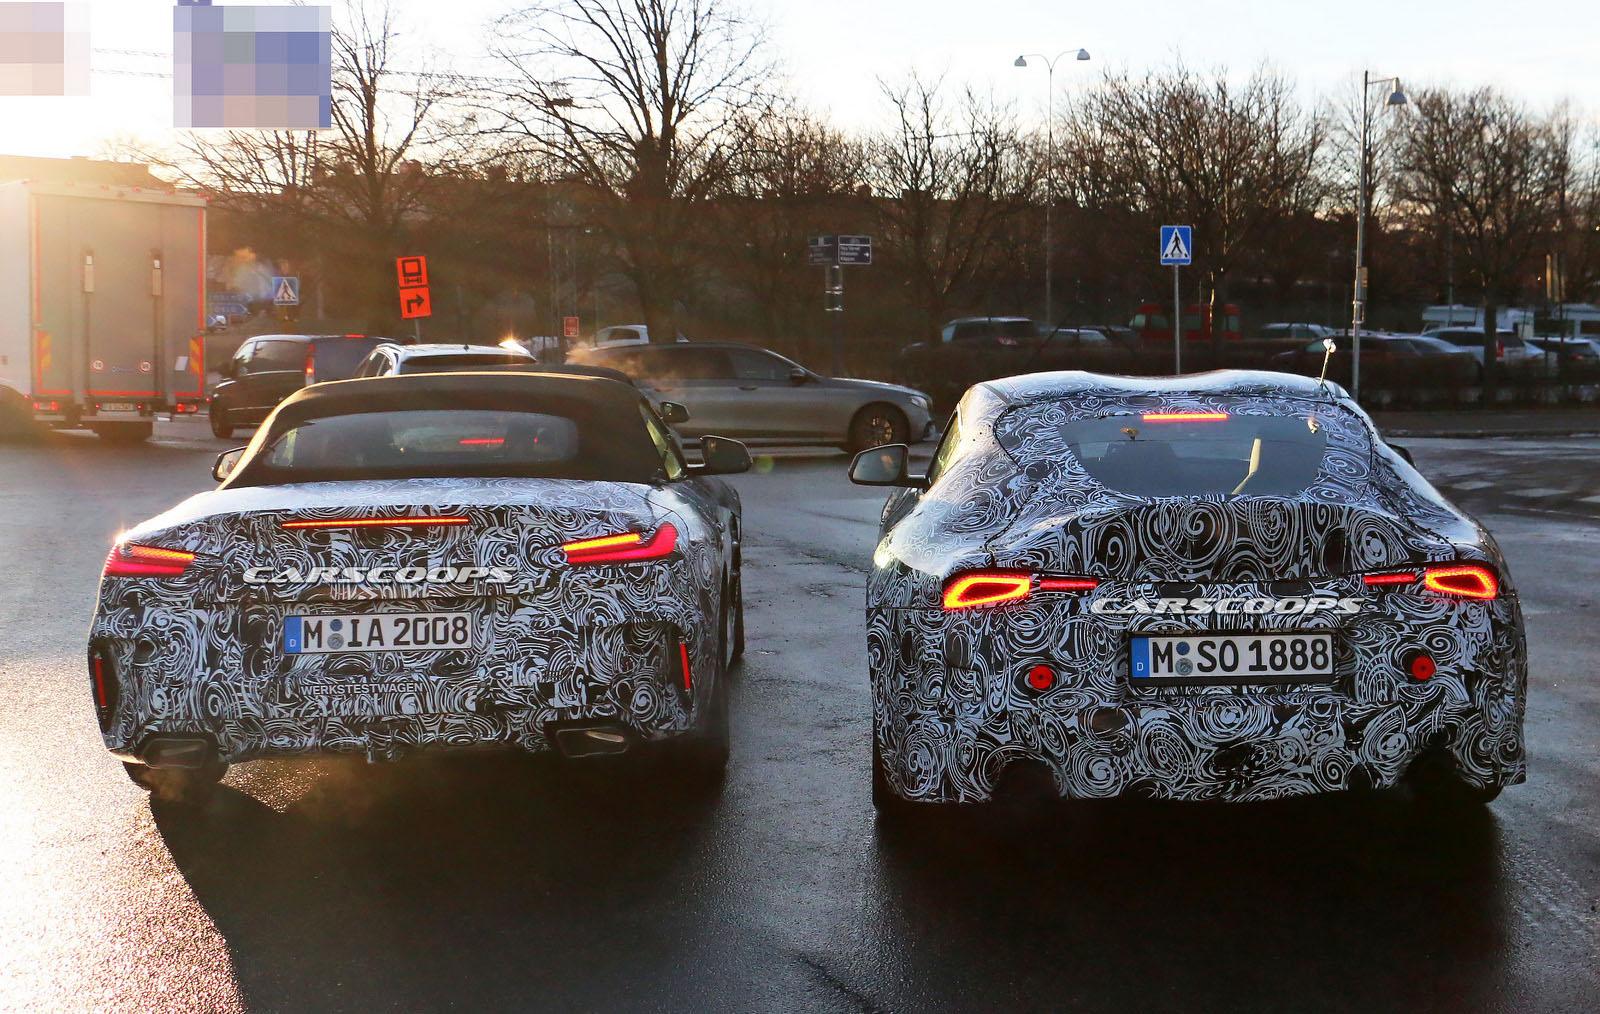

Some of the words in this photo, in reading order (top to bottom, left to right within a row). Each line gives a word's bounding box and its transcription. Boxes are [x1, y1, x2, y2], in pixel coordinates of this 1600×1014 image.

[303, 619, 323, 649] M
[347, 618, 385, 648] IA
[393, 616, 469, 646] 2008
[289, 638, 297, 648] D
[1152, 641, 1174, 674] M
[1197, 639, 1240, 673] SO
[1248, 638, 1330, 672] 1888
[1136, 662, 1144, 672] D
[301, 682, 423, 696] WERKSTESTWAGEN
